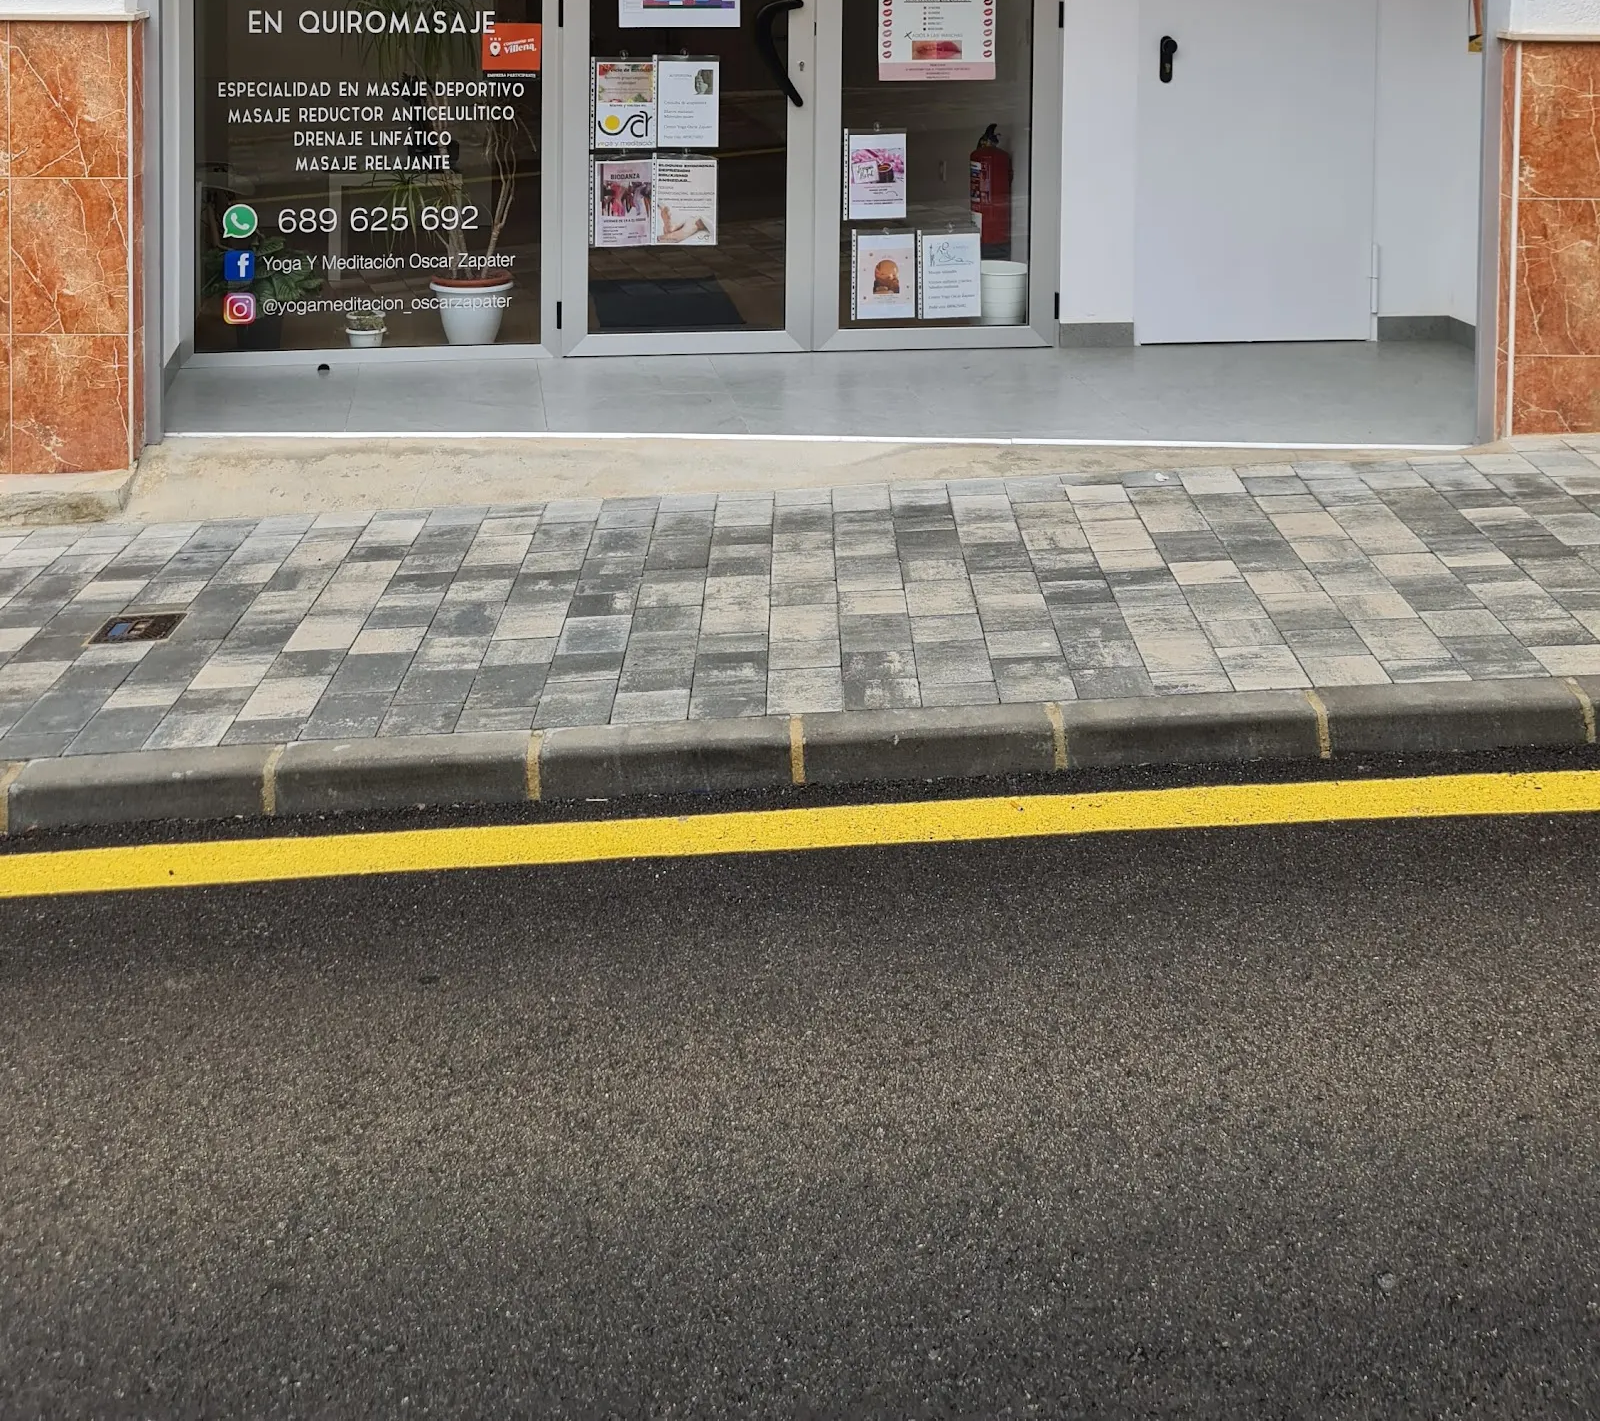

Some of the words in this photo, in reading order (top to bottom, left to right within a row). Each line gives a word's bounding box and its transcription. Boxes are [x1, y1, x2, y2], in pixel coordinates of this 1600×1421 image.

[248, 10, 282, 34] EN
[299, 10, 496, 34] QUIROMASAJE
[218, 81, 331, 98] ESPECIALIDAD
[339, 82, 359, 98] EN
[366, 81, 428, 98] MASAJE
[435, 81, 525, 98] DEPORTIVO
[228, 108, 290, 124] MASAJE
[299, 107, 384, 123] REDUCTOR
[391, 103, 515, 122] ANTICELULÍTICO
[294, 130, 363, 147] DRENAJE
[370, 126, 452, 146] LINFÁTICO
[295, 156, 357, 172] MASAJE
[365, 155, 451, 170] RELAJANTE
[277, 208, 337, 233] 689
[350, 207, 409, 232] 625
[420, 205, 479, 230] 692
[262, 256, 301, 275] Yoga
[306, 255, 318, 270] Y
[322, 254, 404, 270] Meditación
[409, 253, 454, 269] Oscar
[458, 252, 516, 272] Zapater
[262, 295, 512, 316] @yogameditacion_oscarzapater
